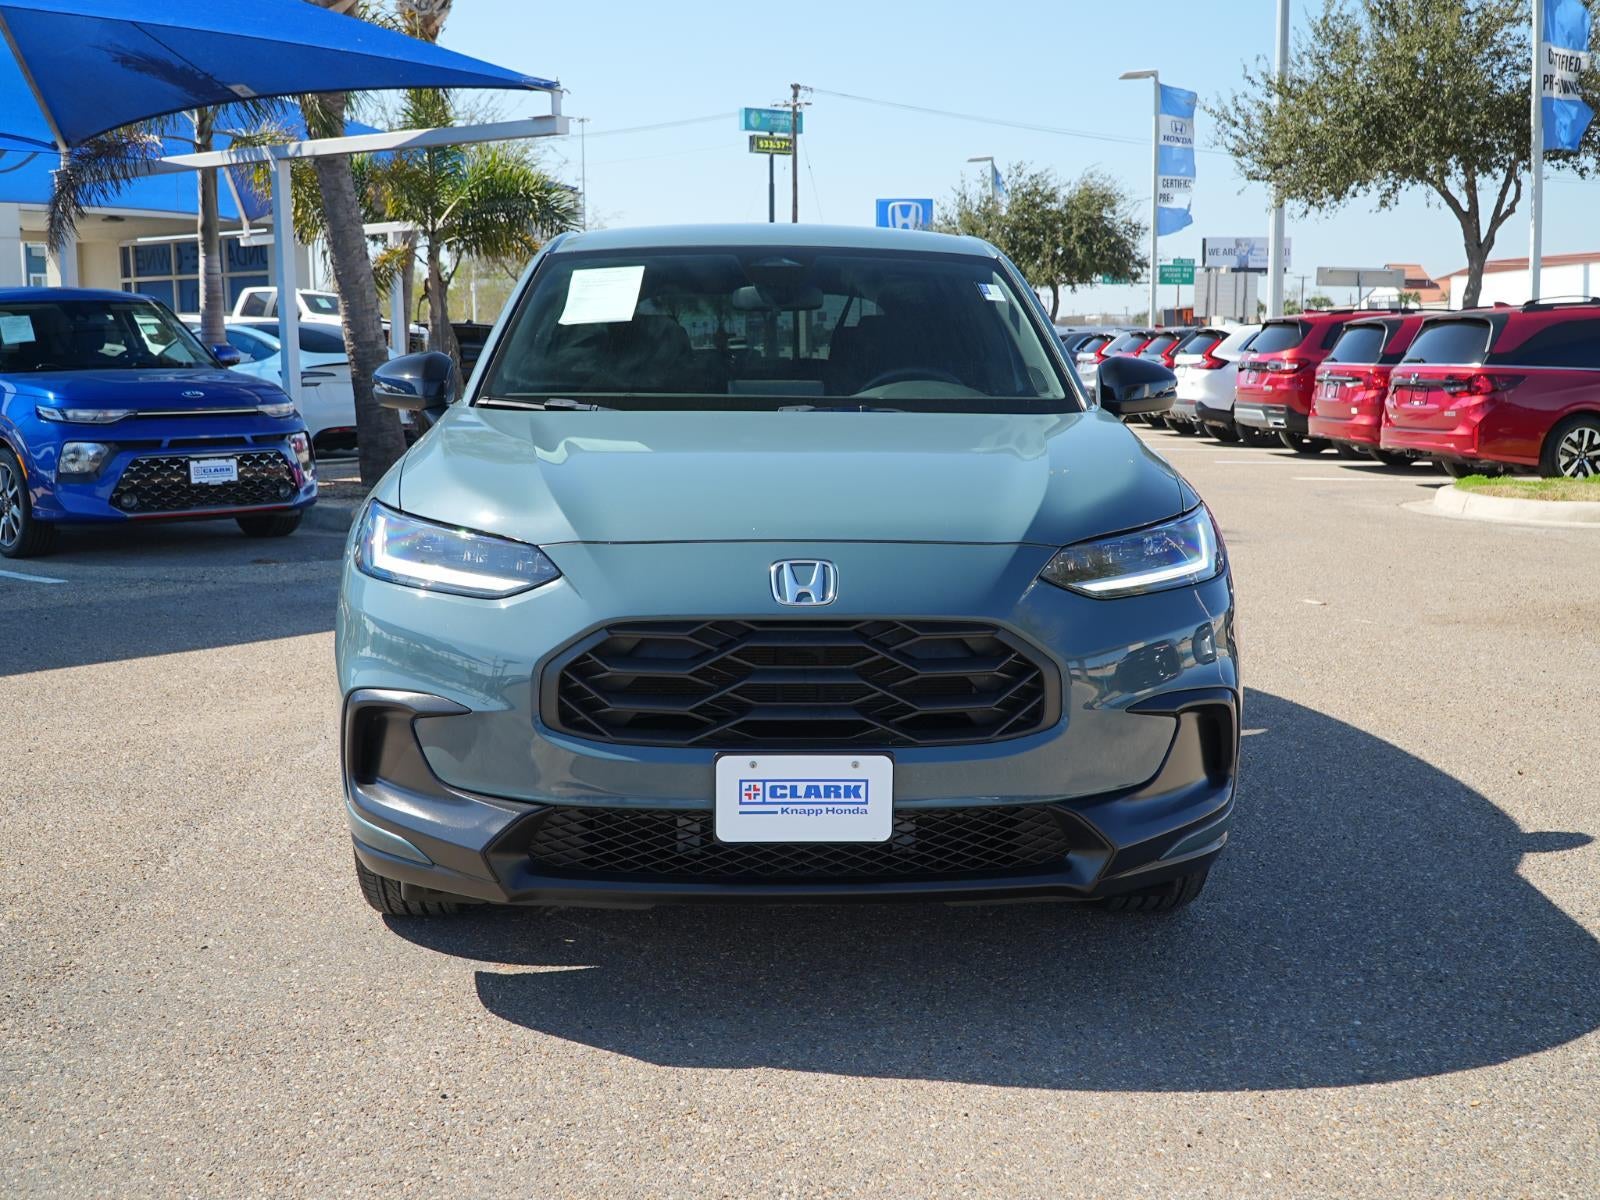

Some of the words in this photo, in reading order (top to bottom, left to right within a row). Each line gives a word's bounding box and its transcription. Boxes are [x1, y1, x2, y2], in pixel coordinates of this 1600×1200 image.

[1163, 134, 1192, 145] HONDA
[1208, 247, 1221, 256] WE
[1222, 247, 1238, 256] ARE
[769, 784, 862, 799] CLARK
[781, 807, 823, 816] Knapp
[826, 807, 868, 815] Honda
